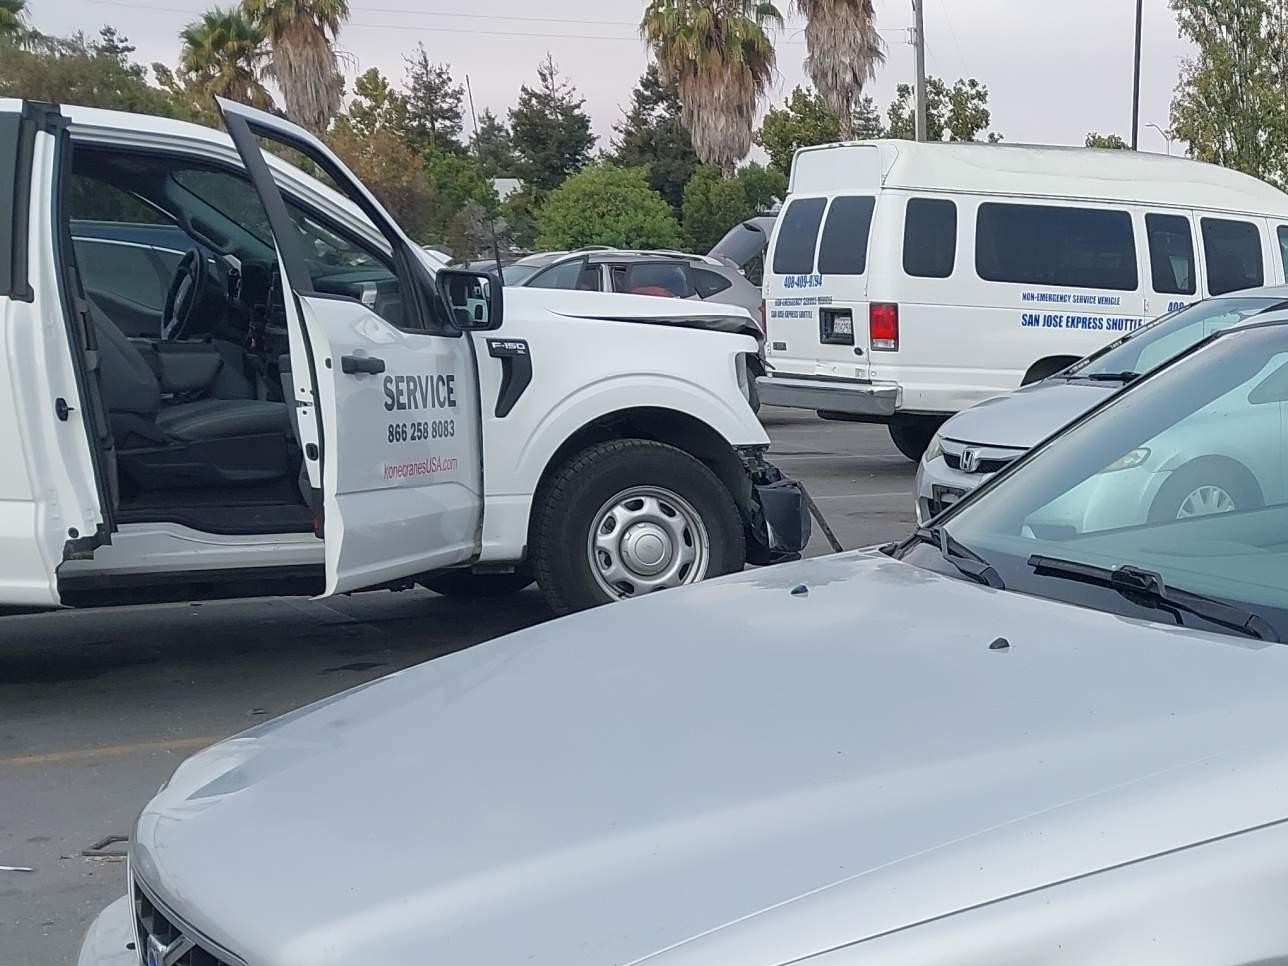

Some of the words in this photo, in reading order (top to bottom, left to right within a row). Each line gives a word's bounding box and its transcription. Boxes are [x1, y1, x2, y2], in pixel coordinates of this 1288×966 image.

[1022, 293, 1071, 304] NON-EMERGENCY
[1073, 295, 1097, 304] SERVICE
[1098, 296, 1120, 305] VEHICLE
[1021, 314, 1041, 327] SAN
[1042, 315, 1064, 328] JOSE
[1066, 316, 1104, 330] EXPRESS
[491, 341, 526, 350] F-150
[383, 375, 457, 412] SERVICE
[388, 424, 407, 443] 866
[410, 422, 429, 441] 258
[432, 420, 455, 438] 8083
